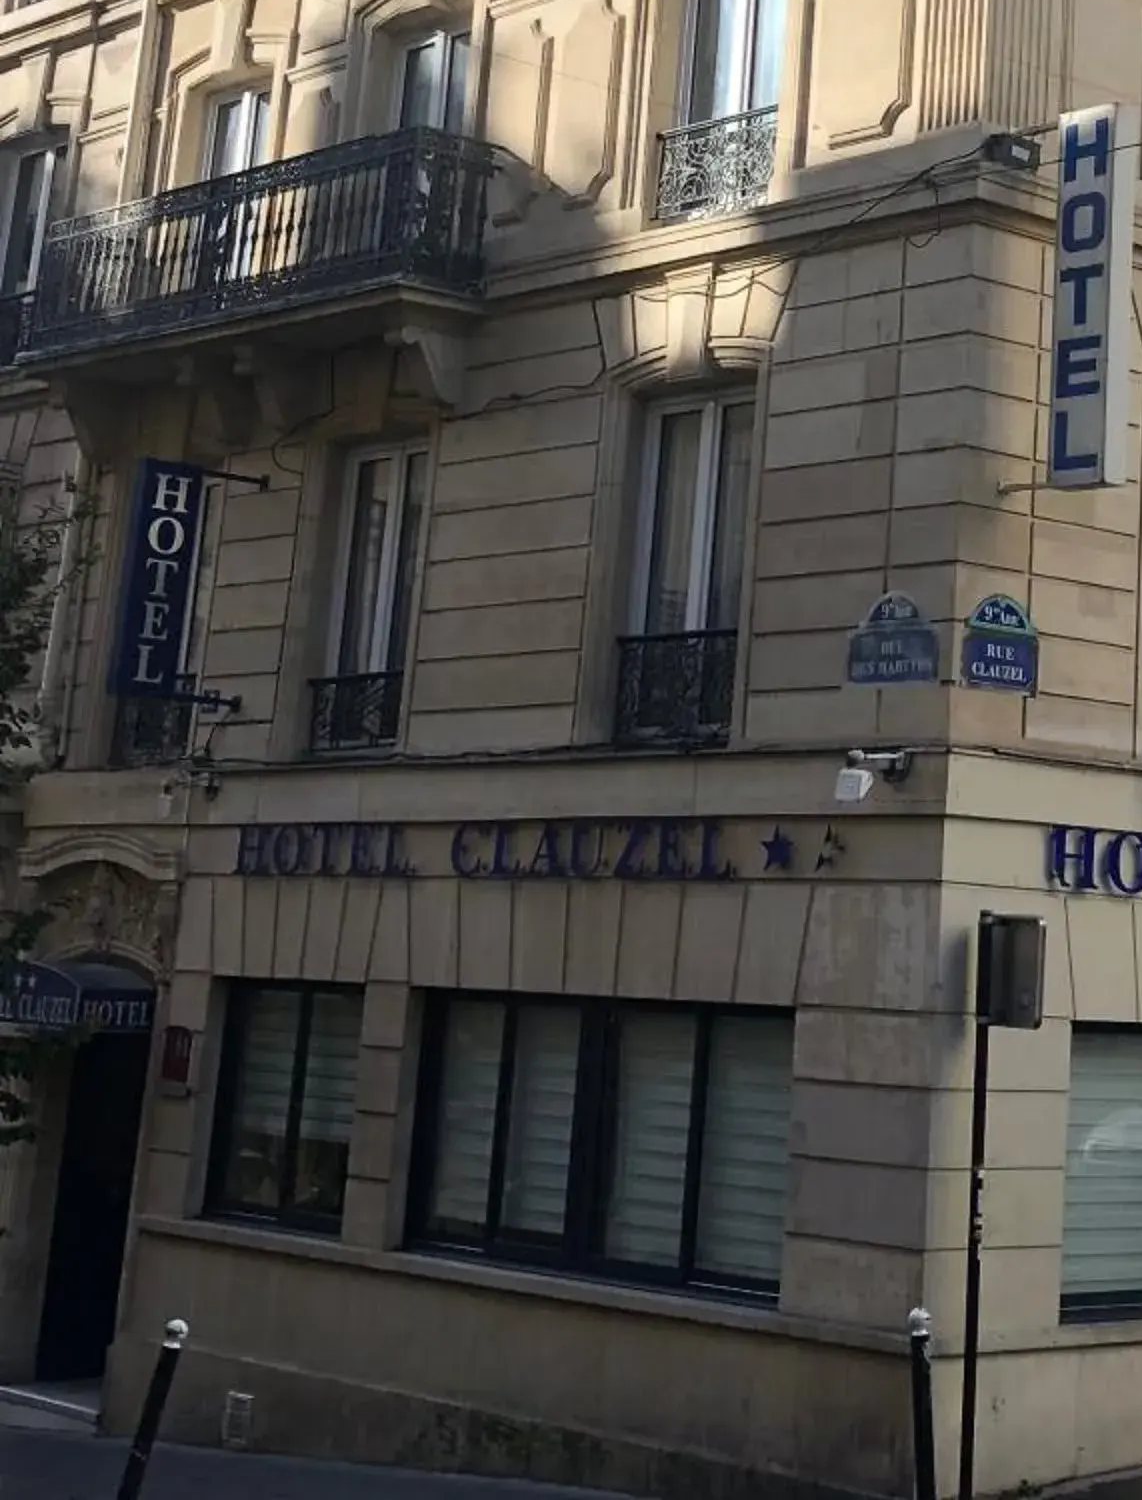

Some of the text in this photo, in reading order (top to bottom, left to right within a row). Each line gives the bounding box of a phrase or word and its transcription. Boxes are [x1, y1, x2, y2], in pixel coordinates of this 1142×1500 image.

[1053, 117, 1109, 471] HOTEL
[132, 472, 193, 685] HOTEL
[971, 661, 1027, 682] CLAUZEL
[986, 643, 1015, 660] RUE
[234, 816, 738, 879] HOTEL CLAUZEL
[83, 999, 149, 1026] HOTEL
